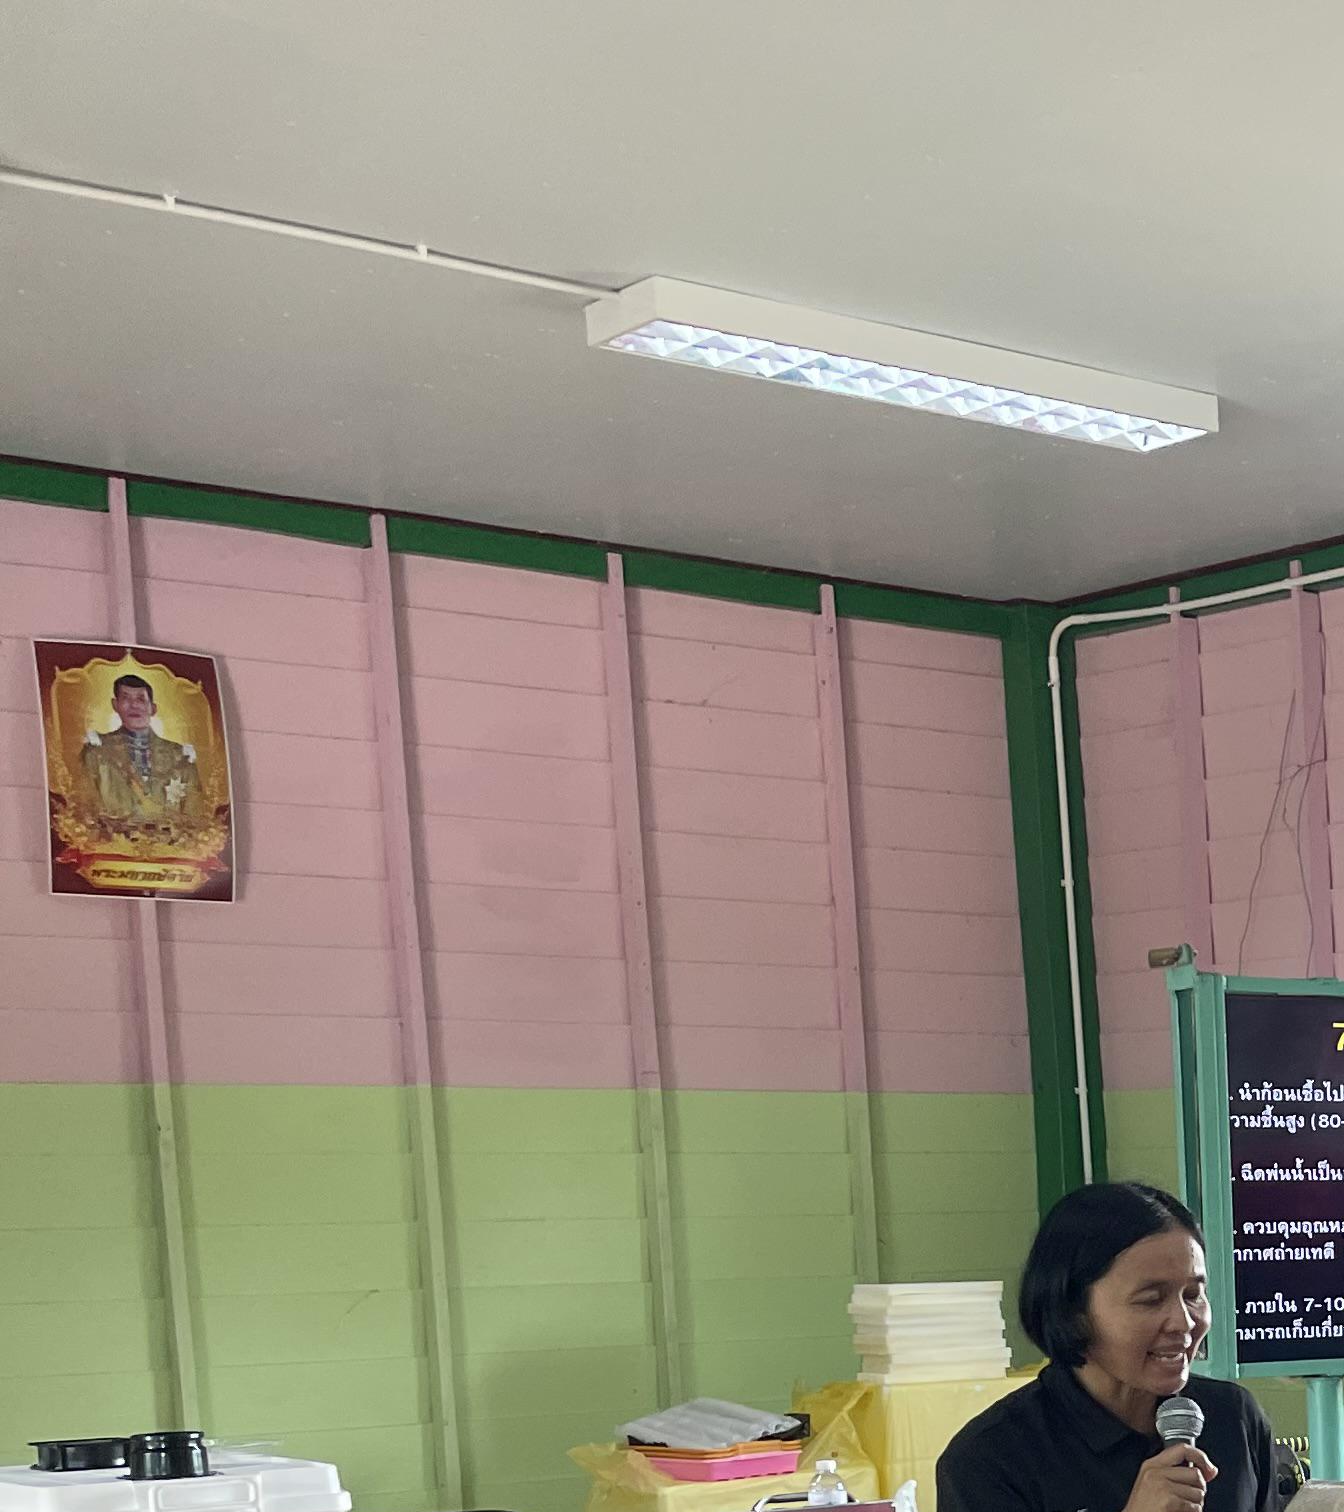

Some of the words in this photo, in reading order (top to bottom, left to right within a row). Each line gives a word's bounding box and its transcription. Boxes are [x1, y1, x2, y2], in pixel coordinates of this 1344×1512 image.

[1230, 1105, 1305, 1134] วามชื้นสูง
[1234, 1241, 1335, 1261] ากาศถ่ายเทดี
[1245, 1292, 1297, 1314] ภายใน
